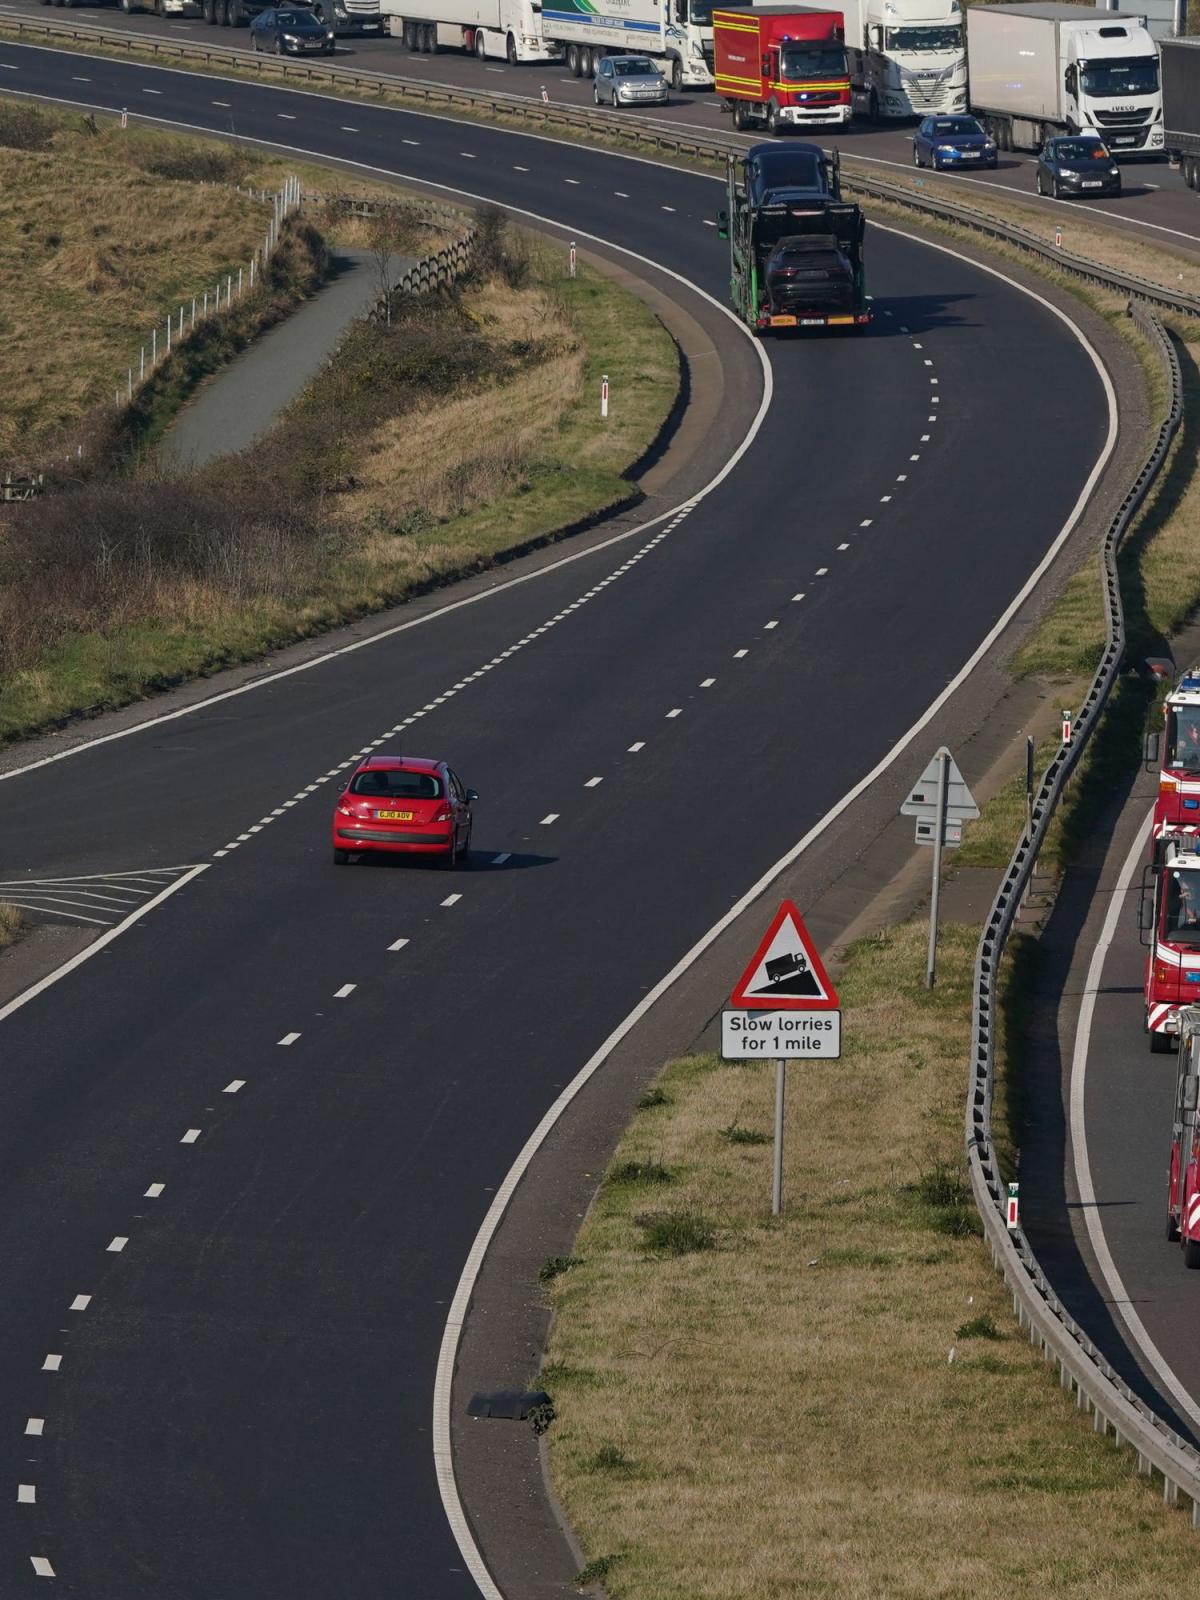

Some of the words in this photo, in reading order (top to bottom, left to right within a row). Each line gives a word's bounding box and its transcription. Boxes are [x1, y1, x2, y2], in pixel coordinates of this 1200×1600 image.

[730, 1017, 773, 1031] Slow
[779, 1017, 833, 1031] lorries
[742, 1036, 766, 1050] for
[773, 1037, 780, 1050] 1
[785, 1037, 822, 1050] mile
